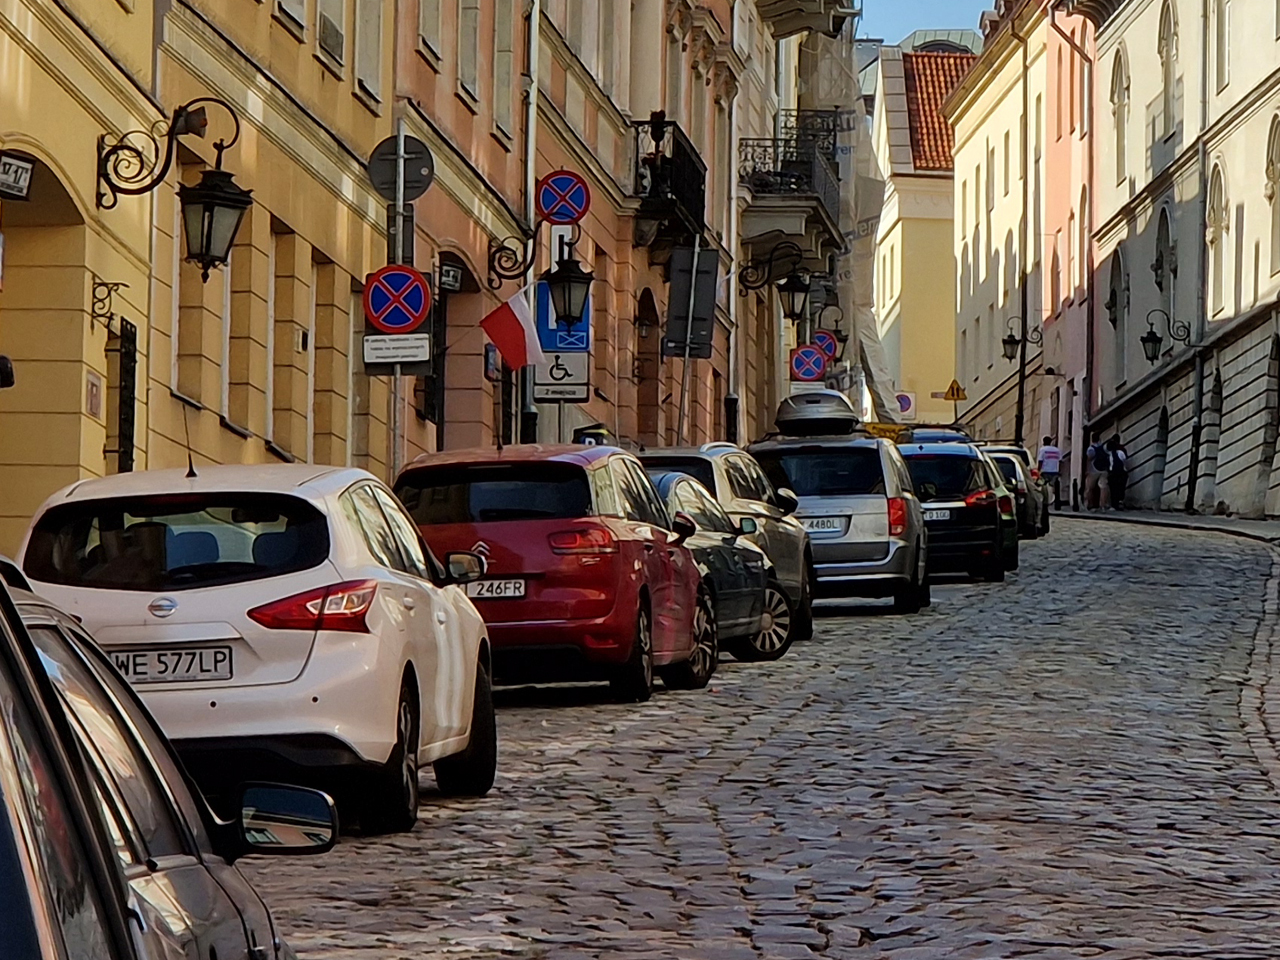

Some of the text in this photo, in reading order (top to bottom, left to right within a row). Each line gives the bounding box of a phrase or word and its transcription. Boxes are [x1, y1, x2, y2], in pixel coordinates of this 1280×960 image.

[476, 581, 523, 596] 246FR
[115, 650, 228, 676] WE 577LP
